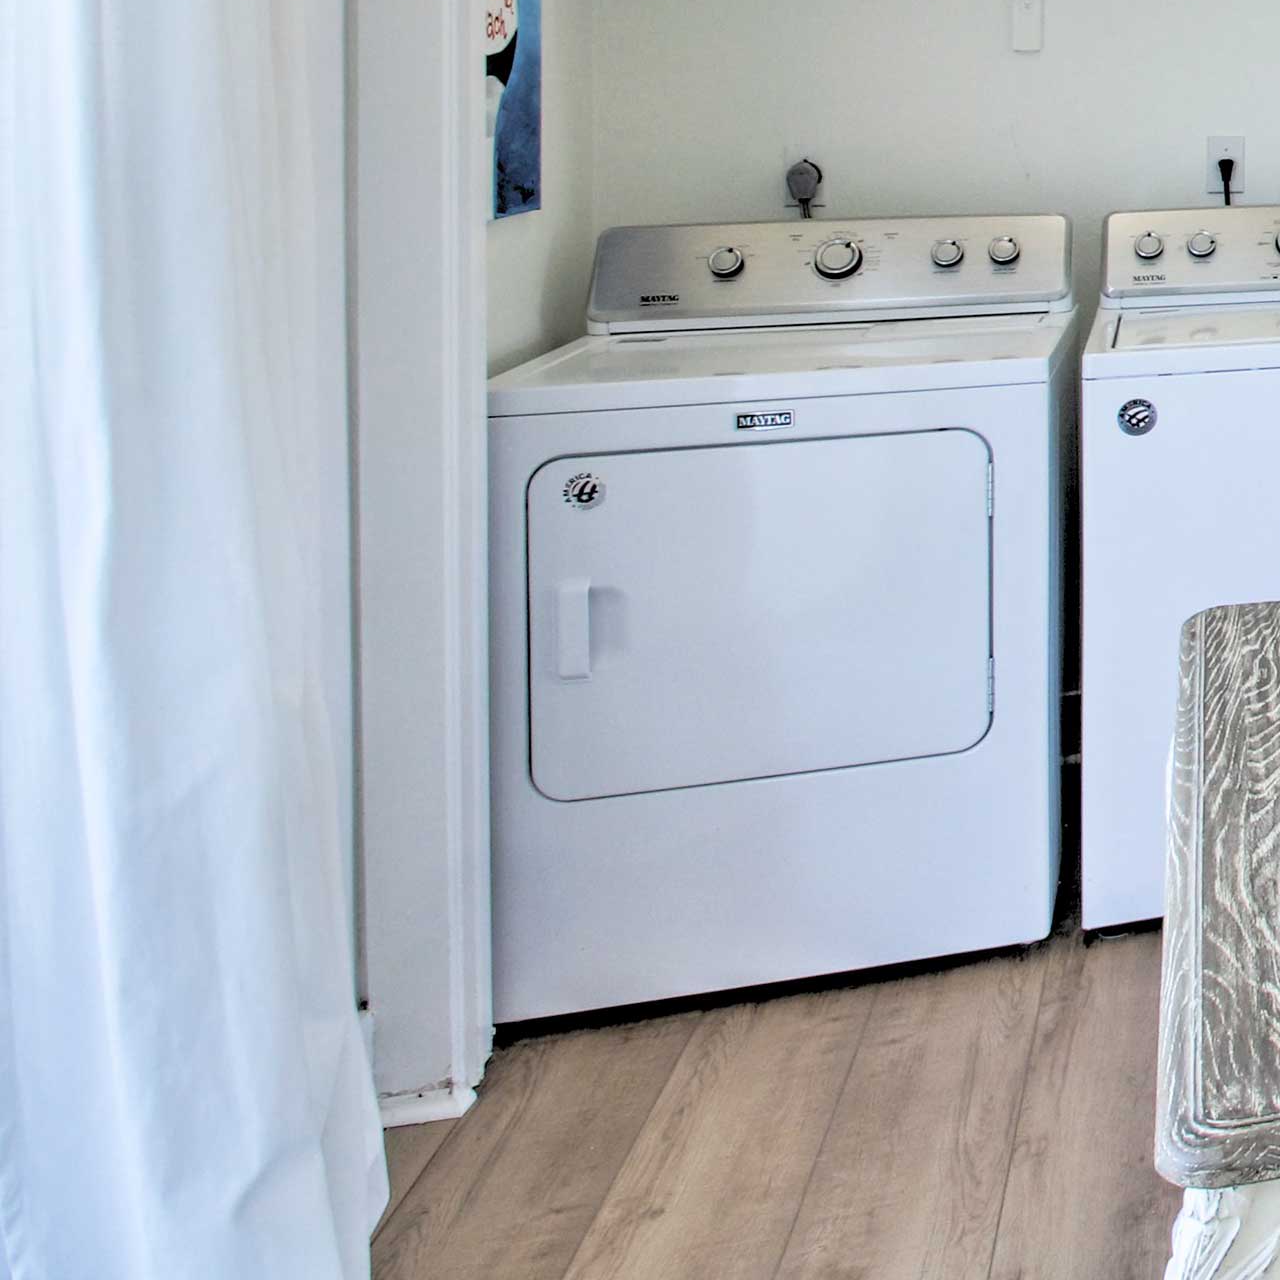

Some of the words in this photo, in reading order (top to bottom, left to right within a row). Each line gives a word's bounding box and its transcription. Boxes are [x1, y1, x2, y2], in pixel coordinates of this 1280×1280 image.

[1132, 274, 1166, 282] MAYTAG
[640, 294, 680, 303] MAYTAG
[738, 414, 791, 427] MAYTAG
